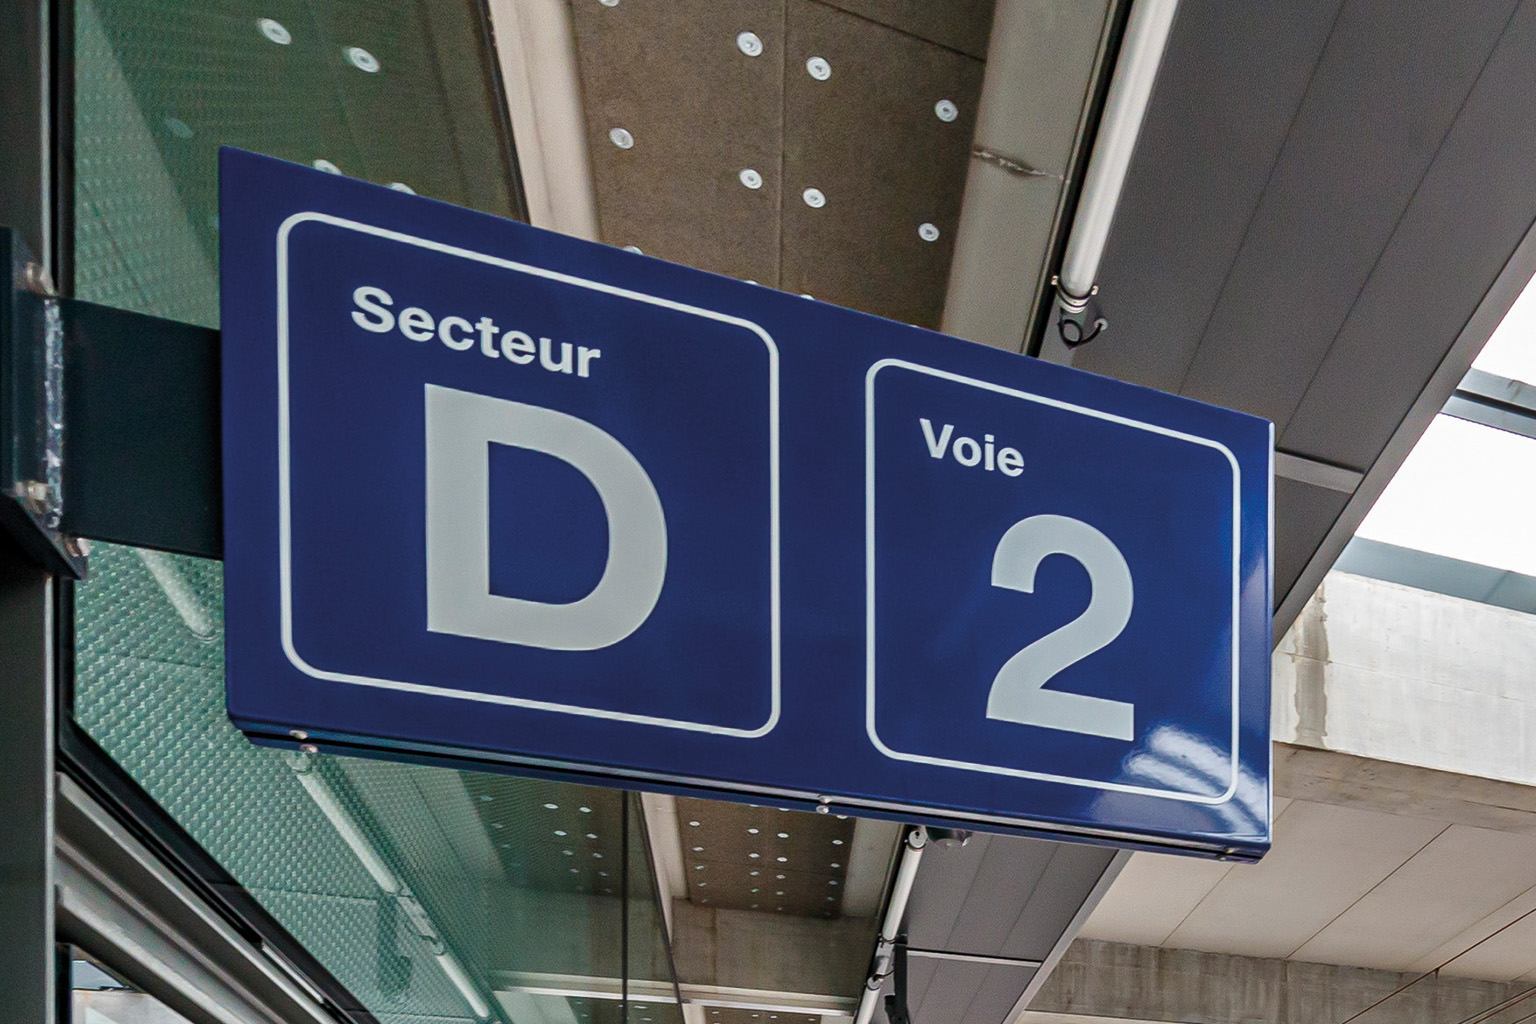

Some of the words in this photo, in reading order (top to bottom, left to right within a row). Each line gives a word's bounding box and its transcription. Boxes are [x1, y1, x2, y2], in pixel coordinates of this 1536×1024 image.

[351, 286, 601, 377] Secteur
[424, 383, 668, 651] D
[919, 418, 1025, 477] Voie
[986, 514, 1134, 741] 2
